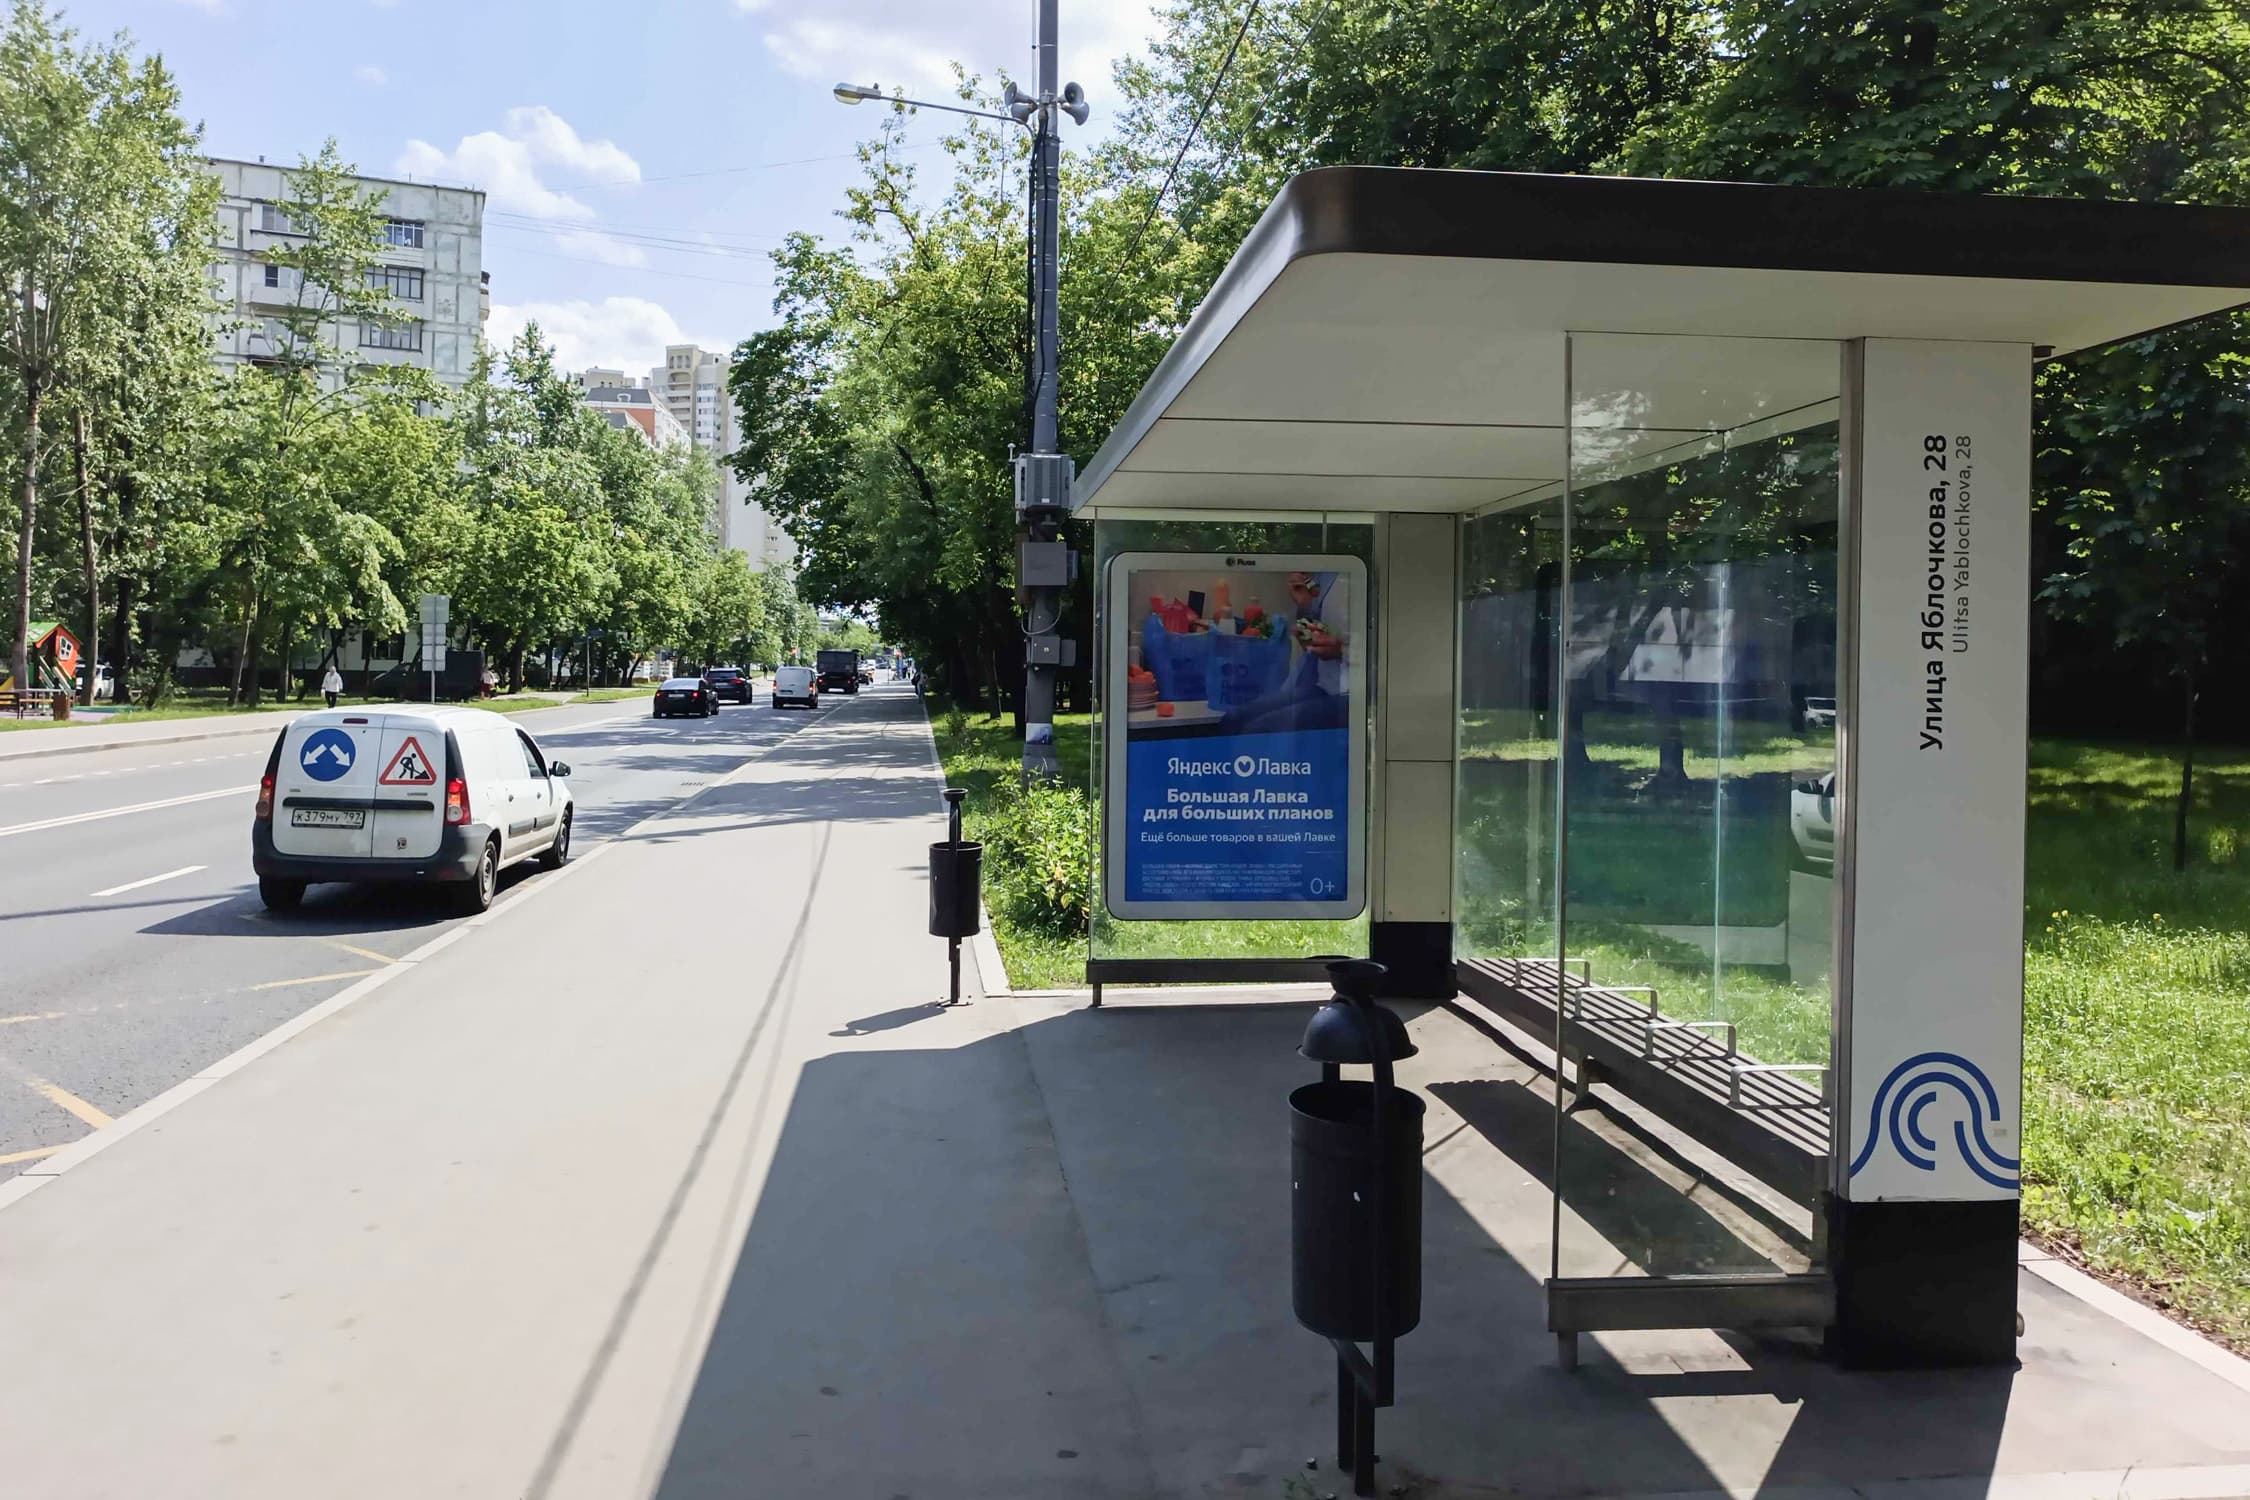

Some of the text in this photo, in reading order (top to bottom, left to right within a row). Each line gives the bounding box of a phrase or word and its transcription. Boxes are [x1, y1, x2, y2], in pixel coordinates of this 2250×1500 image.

[1952, 435, 1973, 654] Ulitsa Yablochkova, 28
[1920, 434, 1950, 750] Улица Яблочкова, 28
[1168, 757, 1311, 776] Яндекс Лавка
[1167, 788, 1308, 803] Большая Лавка
[1144, 806, 1334, 822] для больших планов
[1141, 831, 1164, 843] Ещё
[1166, 832, 1208, 843] больше
[1211, 834, 1255, 845] товаров
[1266, 832, 1301, 842] вашей
[1303, 832, 1336, 842] Лавке
[1310, 877, 1335, 895] 0+
